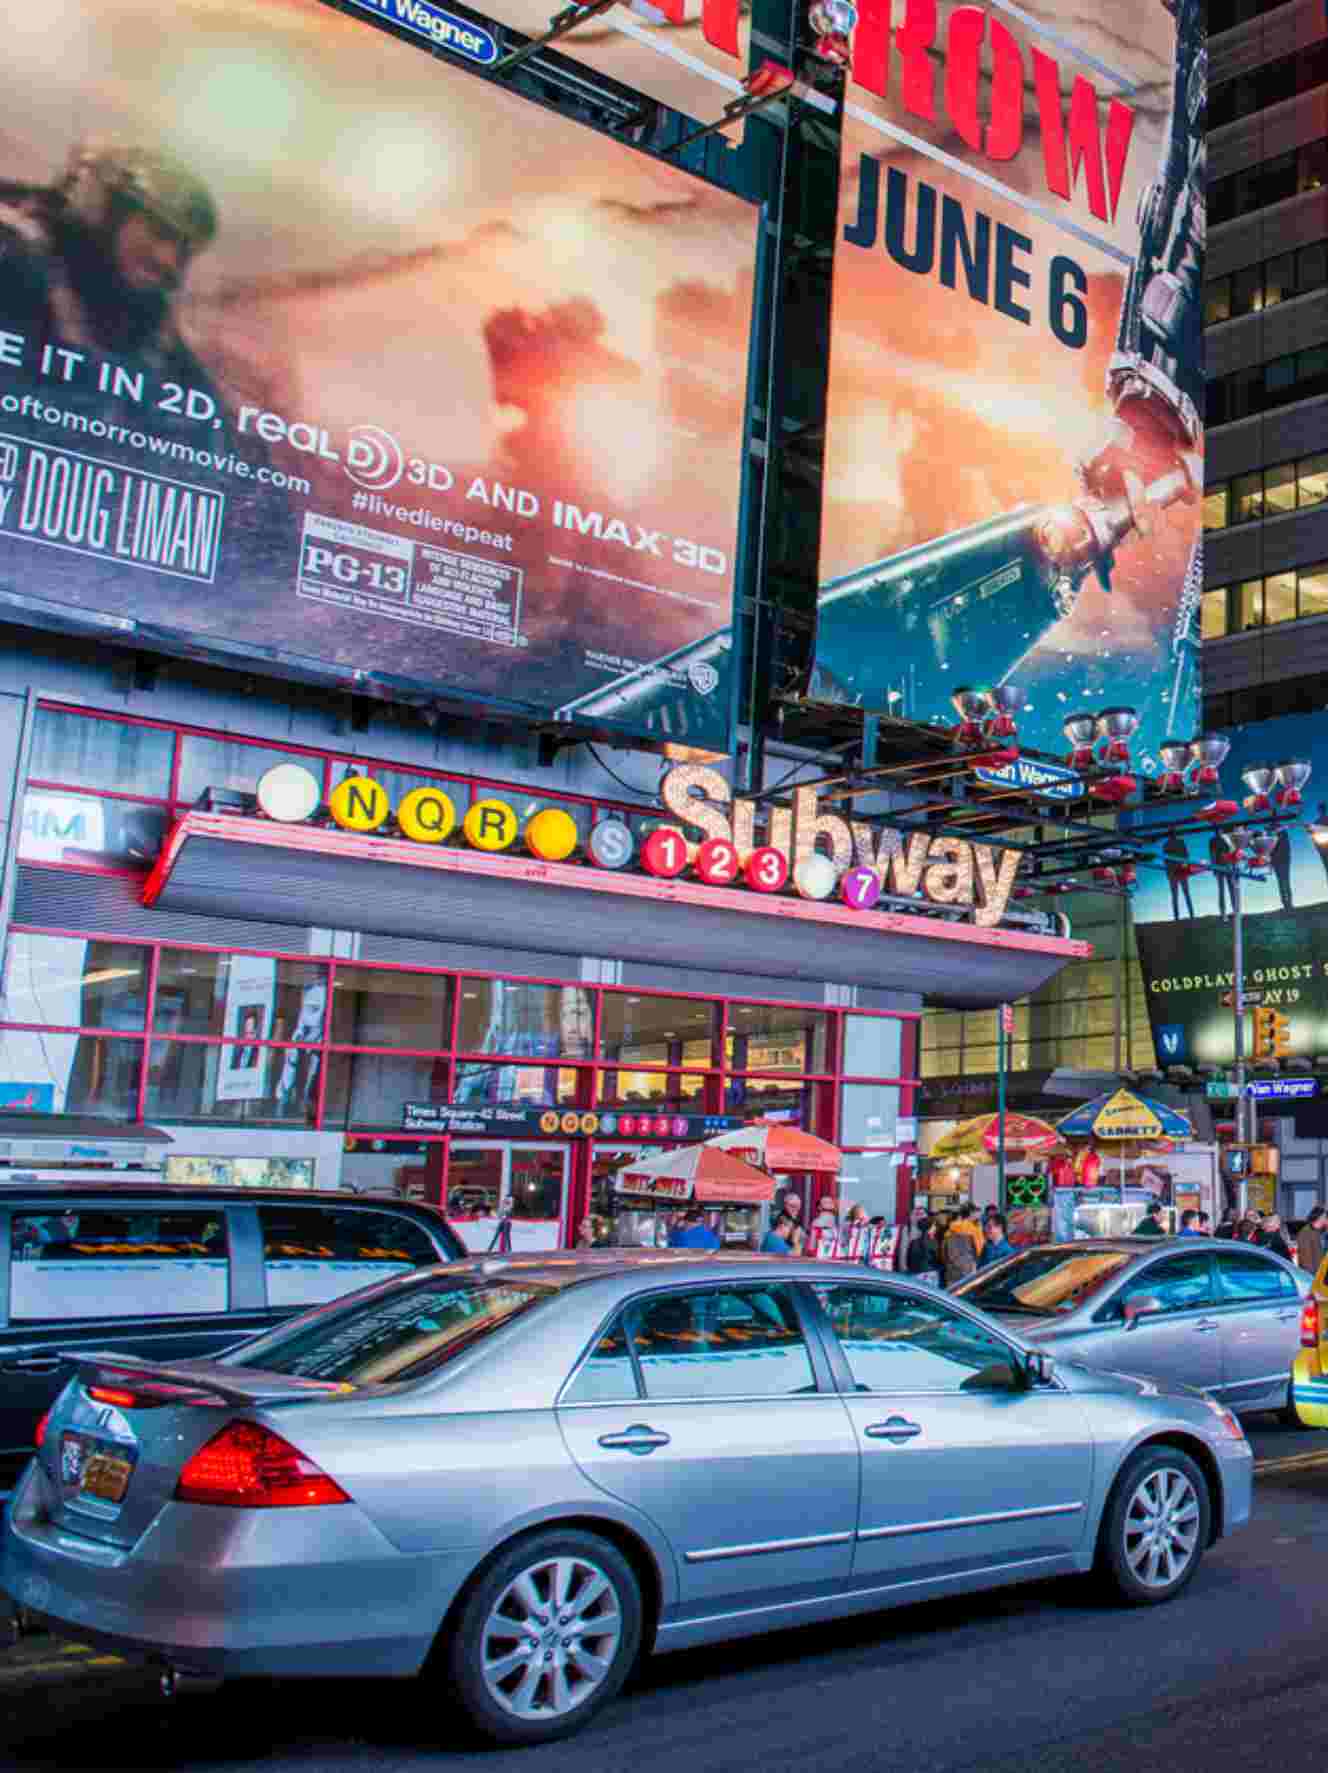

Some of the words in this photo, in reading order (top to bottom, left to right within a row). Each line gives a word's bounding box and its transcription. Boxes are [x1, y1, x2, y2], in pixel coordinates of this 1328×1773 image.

[843, 152, 1033, 326] JUNE
[1049, 255, 1088, 349] 6
[41, 344, 85, 381] IT
[99, 361, 145, 403] IN
[157, 382, 223, 430] 2D,
[407, 458, 454, 492] 3D
[465, 477, 541, 518] AND
[551, 501, 664, 558] IMAX
[671, 537, 727, 576] 3D
[18, 447, 114, 549] DOUG
[114, 475, 217, 575] LIMAN
[304, 545, 406, 594] PG-13
[346, 786, 378, 818] N
[414, 797, 446, 834] Q
[478, 809, 508, 842] R
[600, 829, 627, 860] S
[659, 838, 676, 868] 1
[660, 763, 1024, 928] Subway
[709, 847, 732, 879] 2
[758, 853, 781, 884] 3
[855, 874, 875, 902] 7
[1151, 971, 1234, 994] COLDPLAY
[1253, 964, 1313, 984] GHOST
